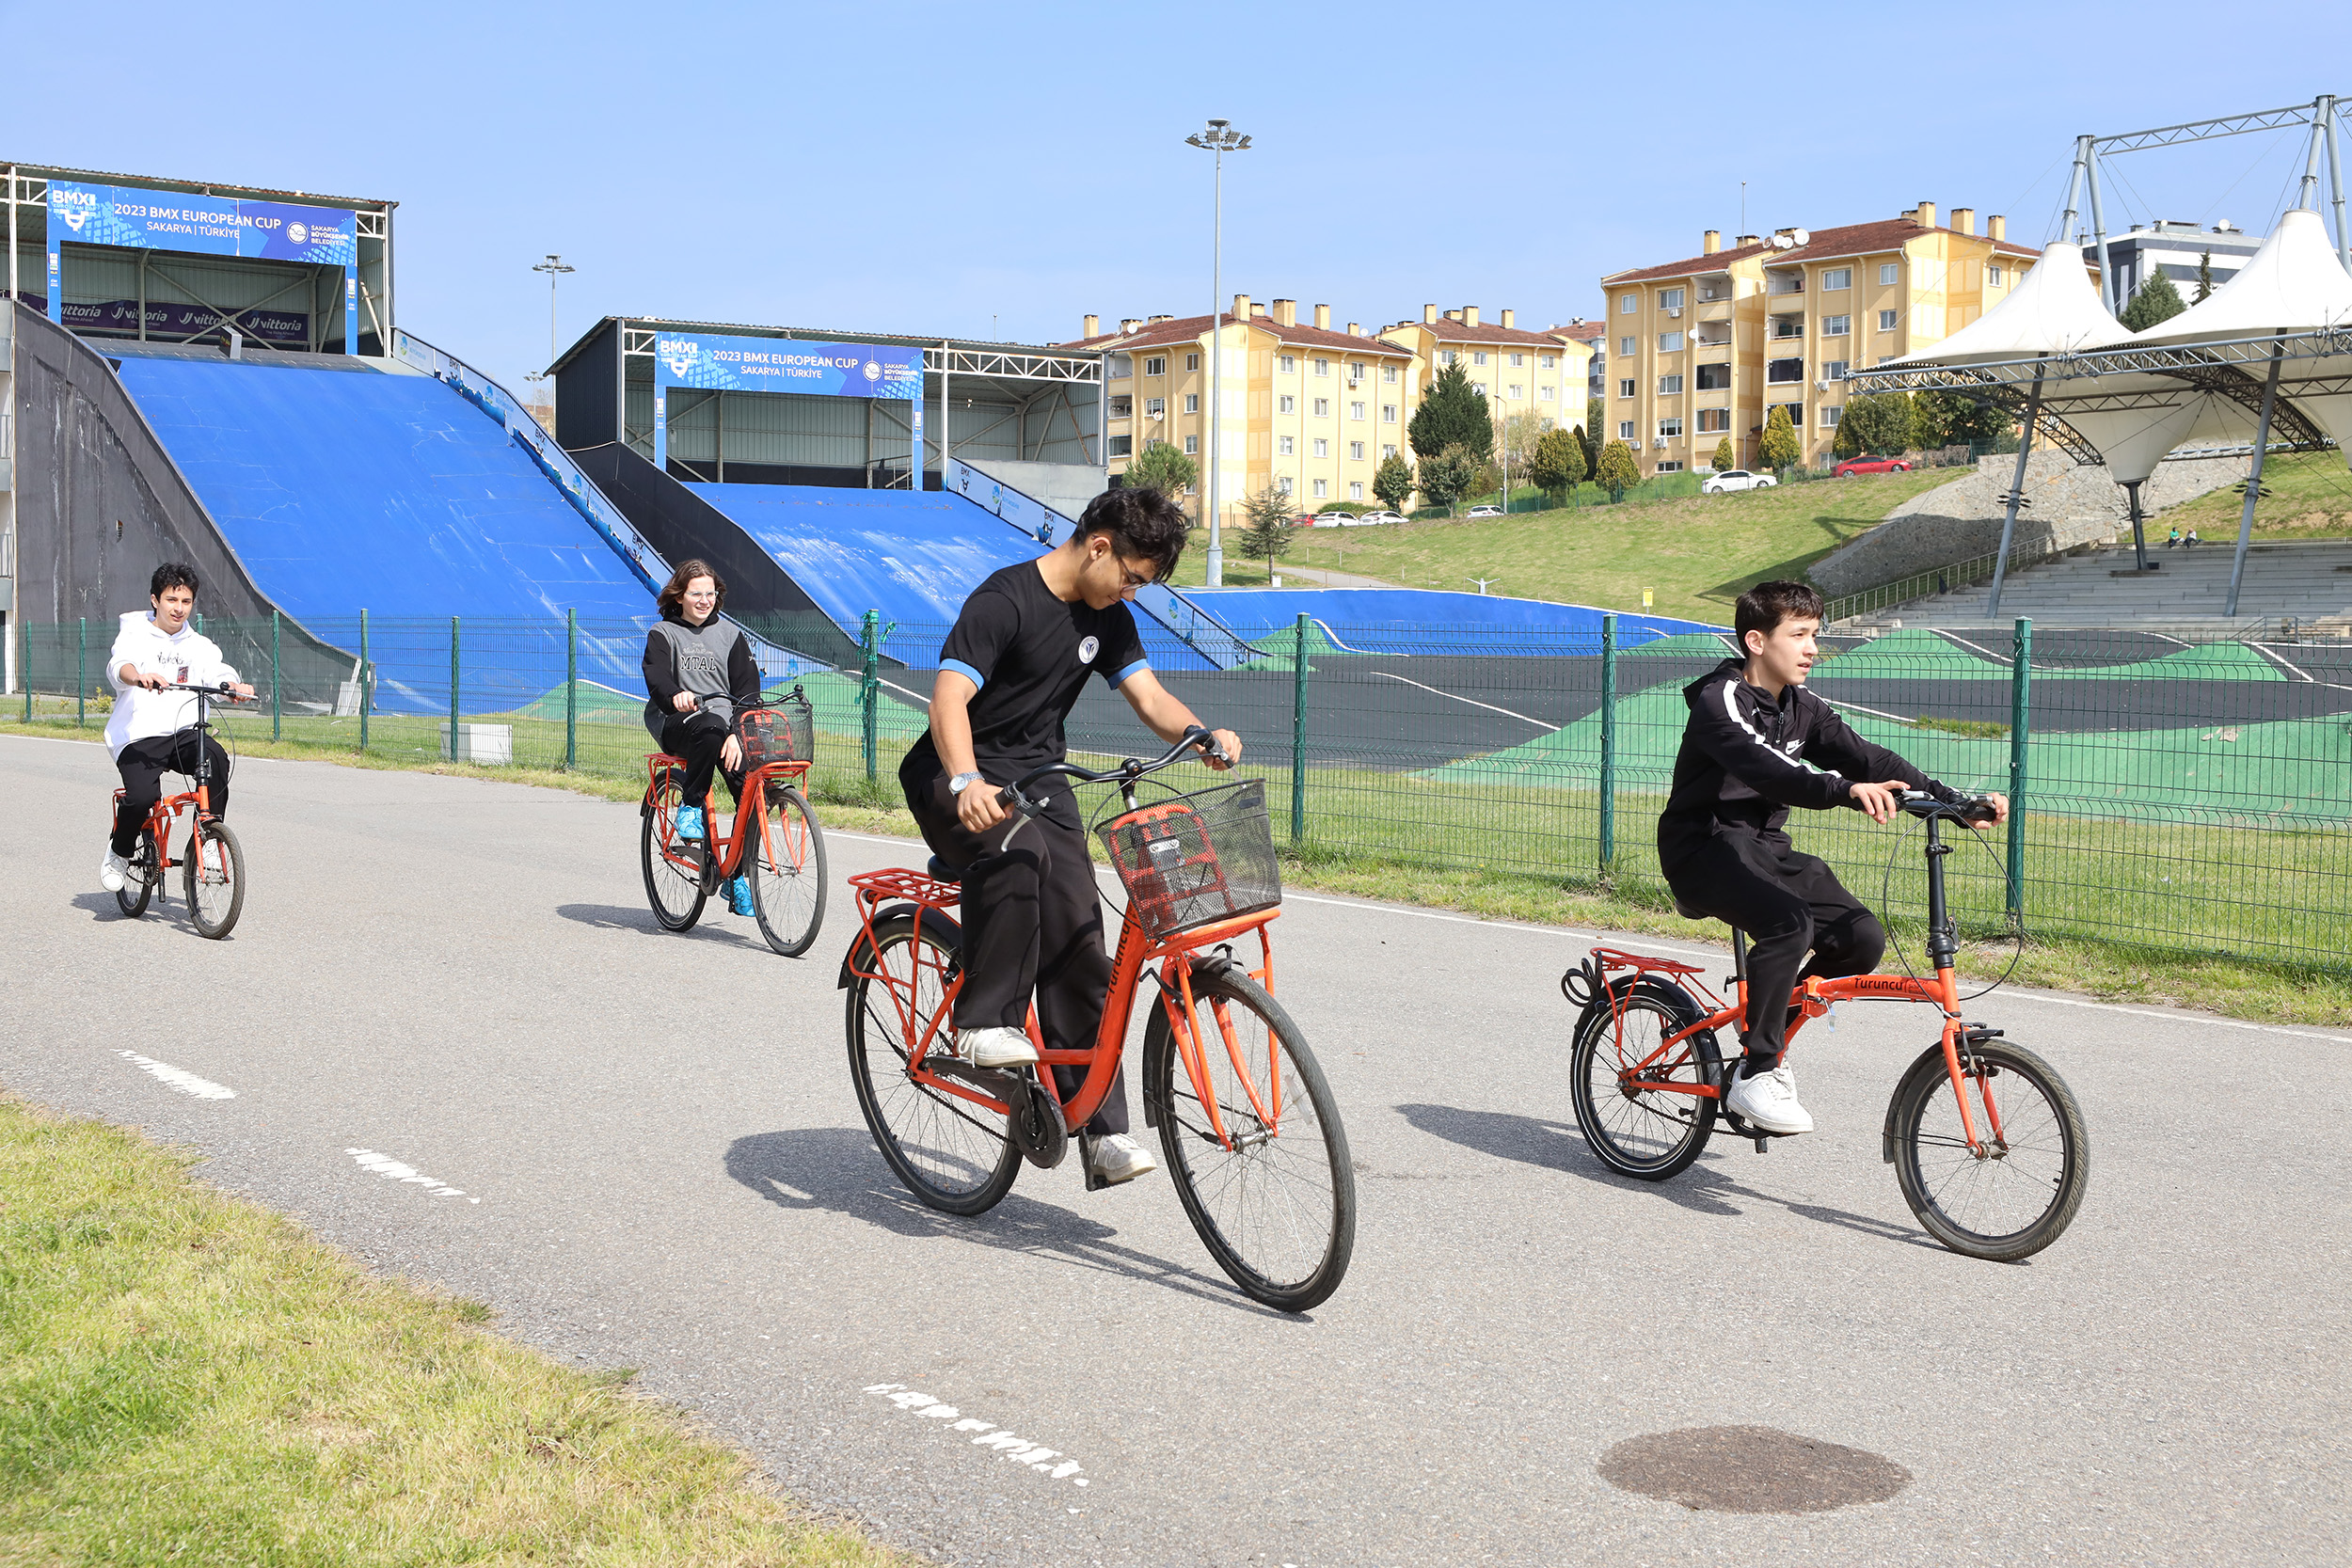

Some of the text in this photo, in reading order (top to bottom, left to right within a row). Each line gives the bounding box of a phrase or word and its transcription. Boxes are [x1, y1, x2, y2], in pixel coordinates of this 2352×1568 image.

[53, 190, 89, 205] BMX
[114, 203, 282, 230] 2023 BMX EUROPEAN CUP
[147, 221, 192, 233] SAKARYA
[199, 225, 240, 239] TÜRKİYE
[125, 309, 168, 322] vitoria
[261, 318, 302, 331] vittoria
[660, 340, 691, 354] BMX
[713, 350, 858, 369] 2023 BMX EUROPEAN CUP
[740, 365, 780, 376] SAKARYA
[786, 367, 822, 378] TÜRKİYE
[534, 428, 546, 443] BMX
[961, 467, 970, 477] BMX
[680, 656, 716, 672] MTAL
[1854, 977, 1904, 990] Turuncu
